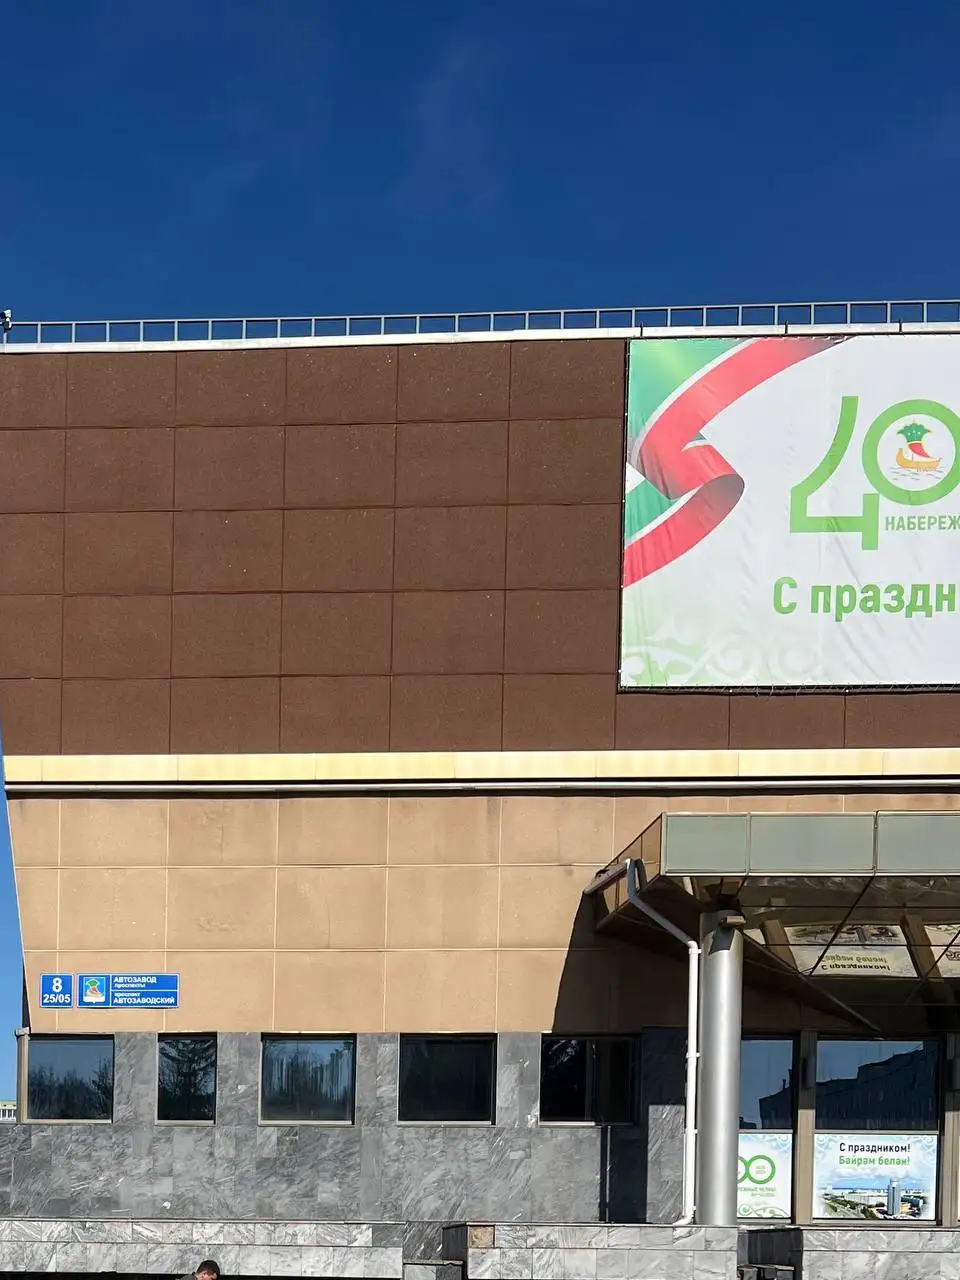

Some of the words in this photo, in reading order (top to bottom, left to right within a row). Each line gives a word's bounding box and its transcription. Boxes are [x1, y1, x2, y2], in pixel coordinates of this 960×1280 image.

[772, 576, 797, 614] С
[810, 583, 956, 622] праздн
[52, 977, 63, 993] 8
[113, 976, 157, 984] АВТОЗАВОД
[43, 994, 71, 1004] 25/05
[113, 996, 175, 1004] АВТОЗАВОДСКИЙ
[839, 1142, 846, 1152] С
[848, 1143, 911, 1154] праздником!
